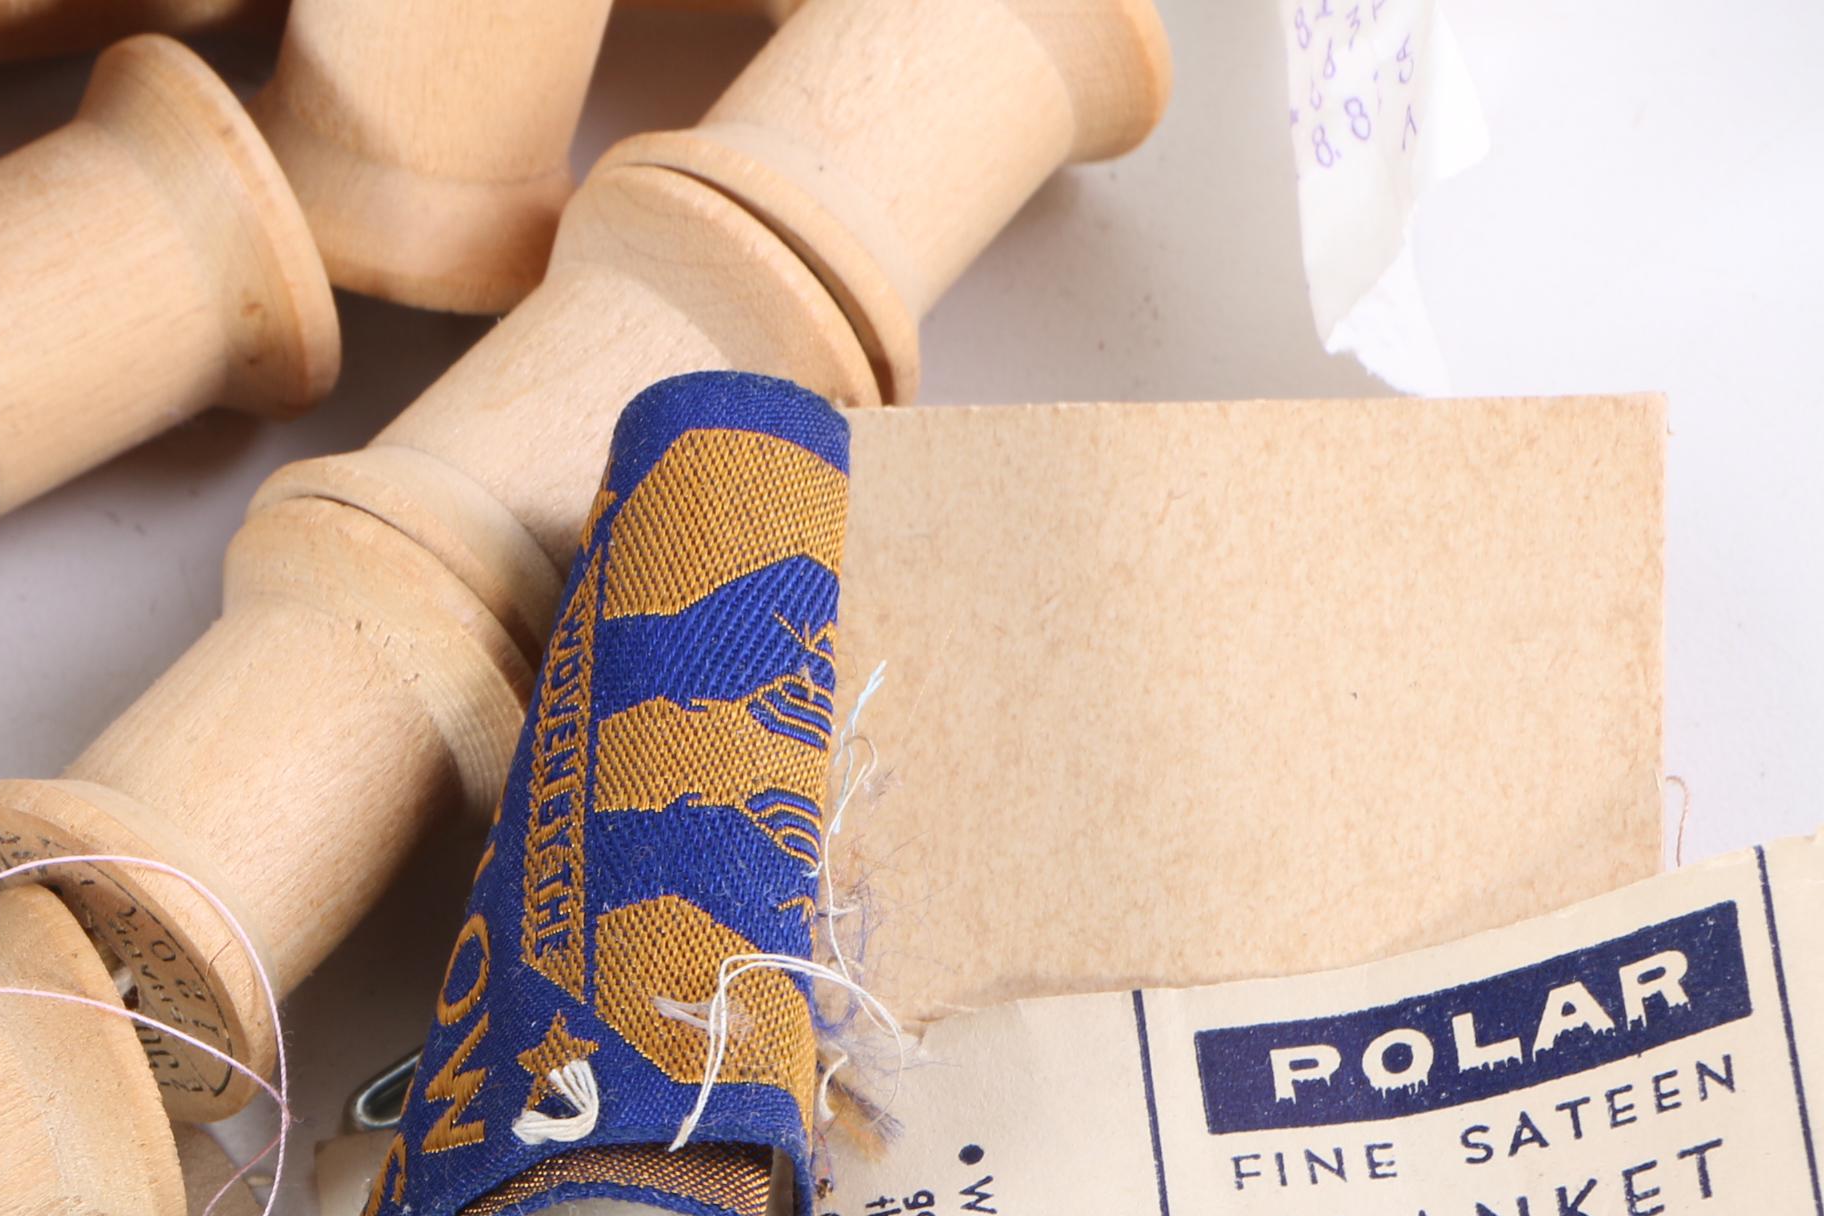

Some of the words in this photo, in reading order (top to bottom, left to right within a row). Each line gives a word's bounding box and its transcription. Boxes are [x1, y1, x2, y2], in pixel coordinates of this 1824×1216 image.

[532, 613, 588, 794] WOVEN
[534, 858, 575, 958] THE
[1269, 949, 1692, 1105] POLAR
[1231, 1142, 1399, 1190] FINE
[1460, 1054, 1737, 1165] SATEEN
